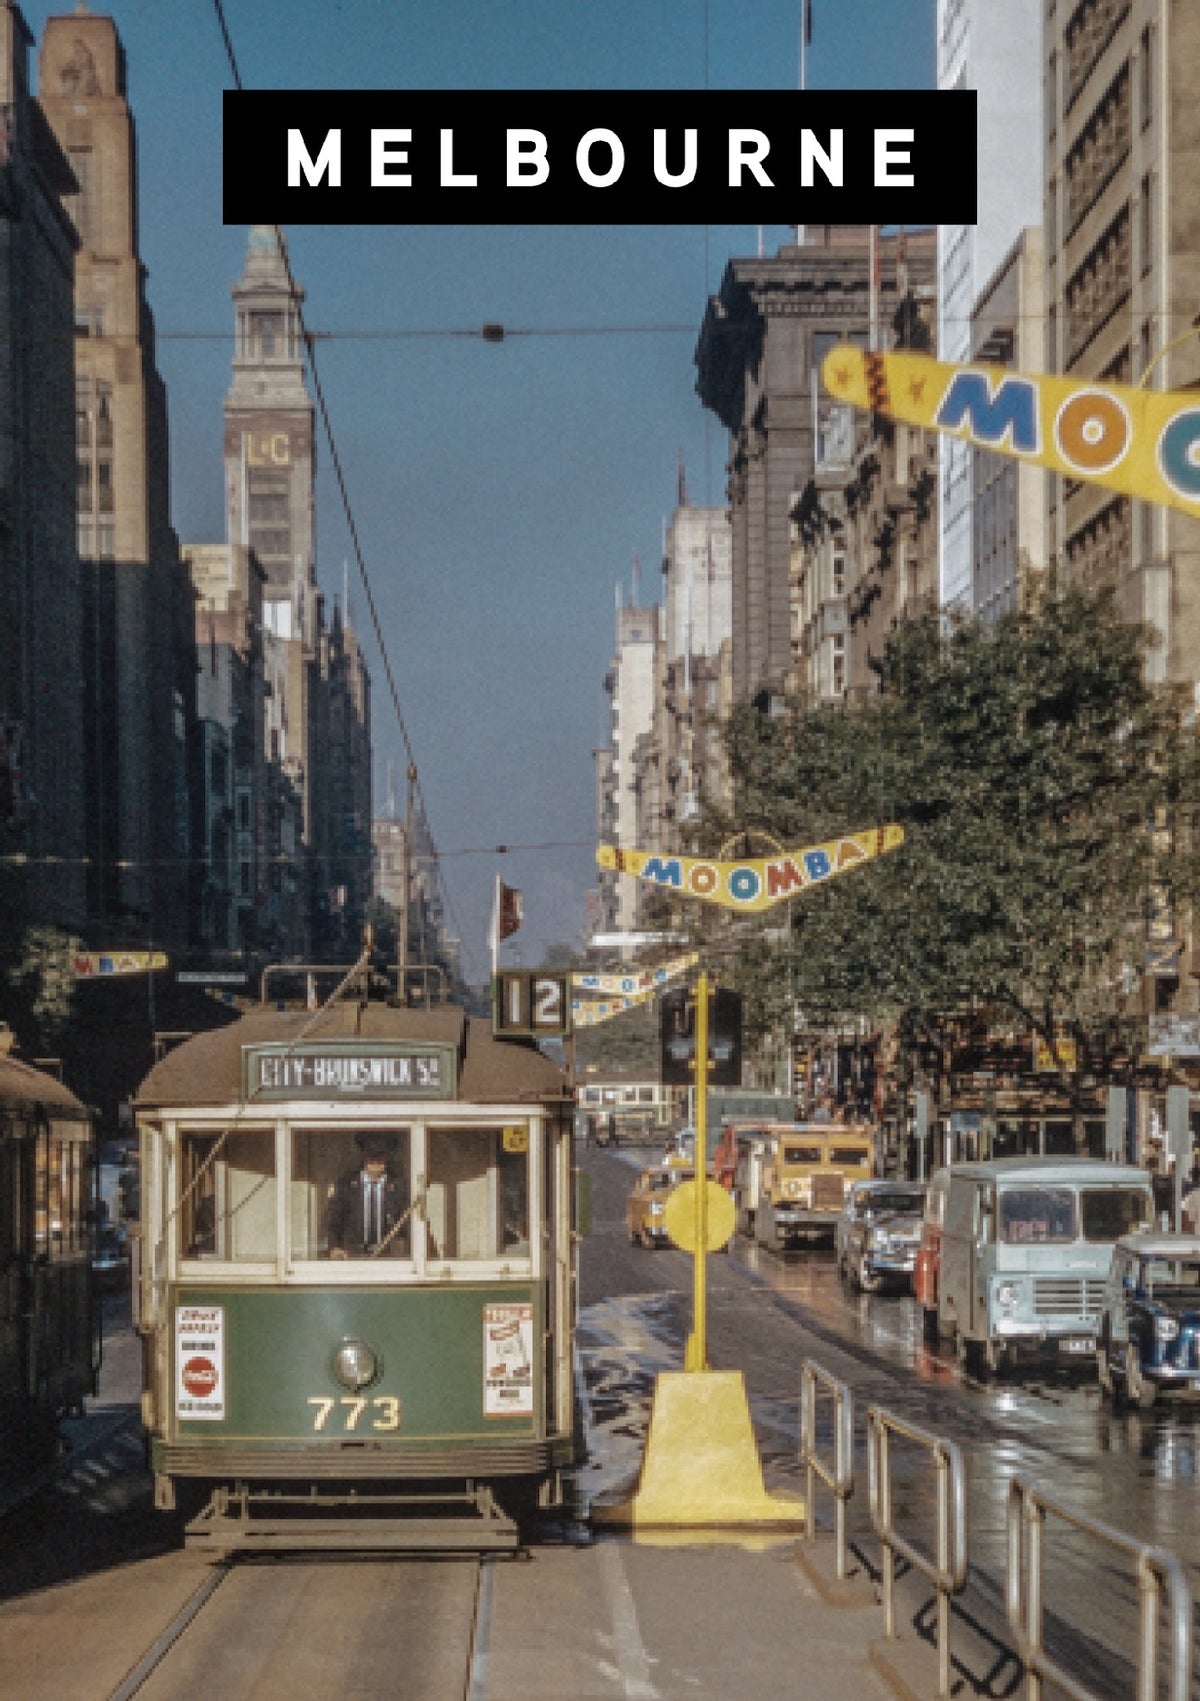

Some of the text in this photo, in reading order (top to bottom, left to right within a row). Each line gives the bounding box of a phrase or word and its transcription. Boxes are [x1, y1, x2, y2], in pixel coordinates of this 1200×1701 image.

[641, 838, 868, 903] MOOMBA
[509, 978, 561, 1023] 12
[307, 1396, 400, 1431] 773
